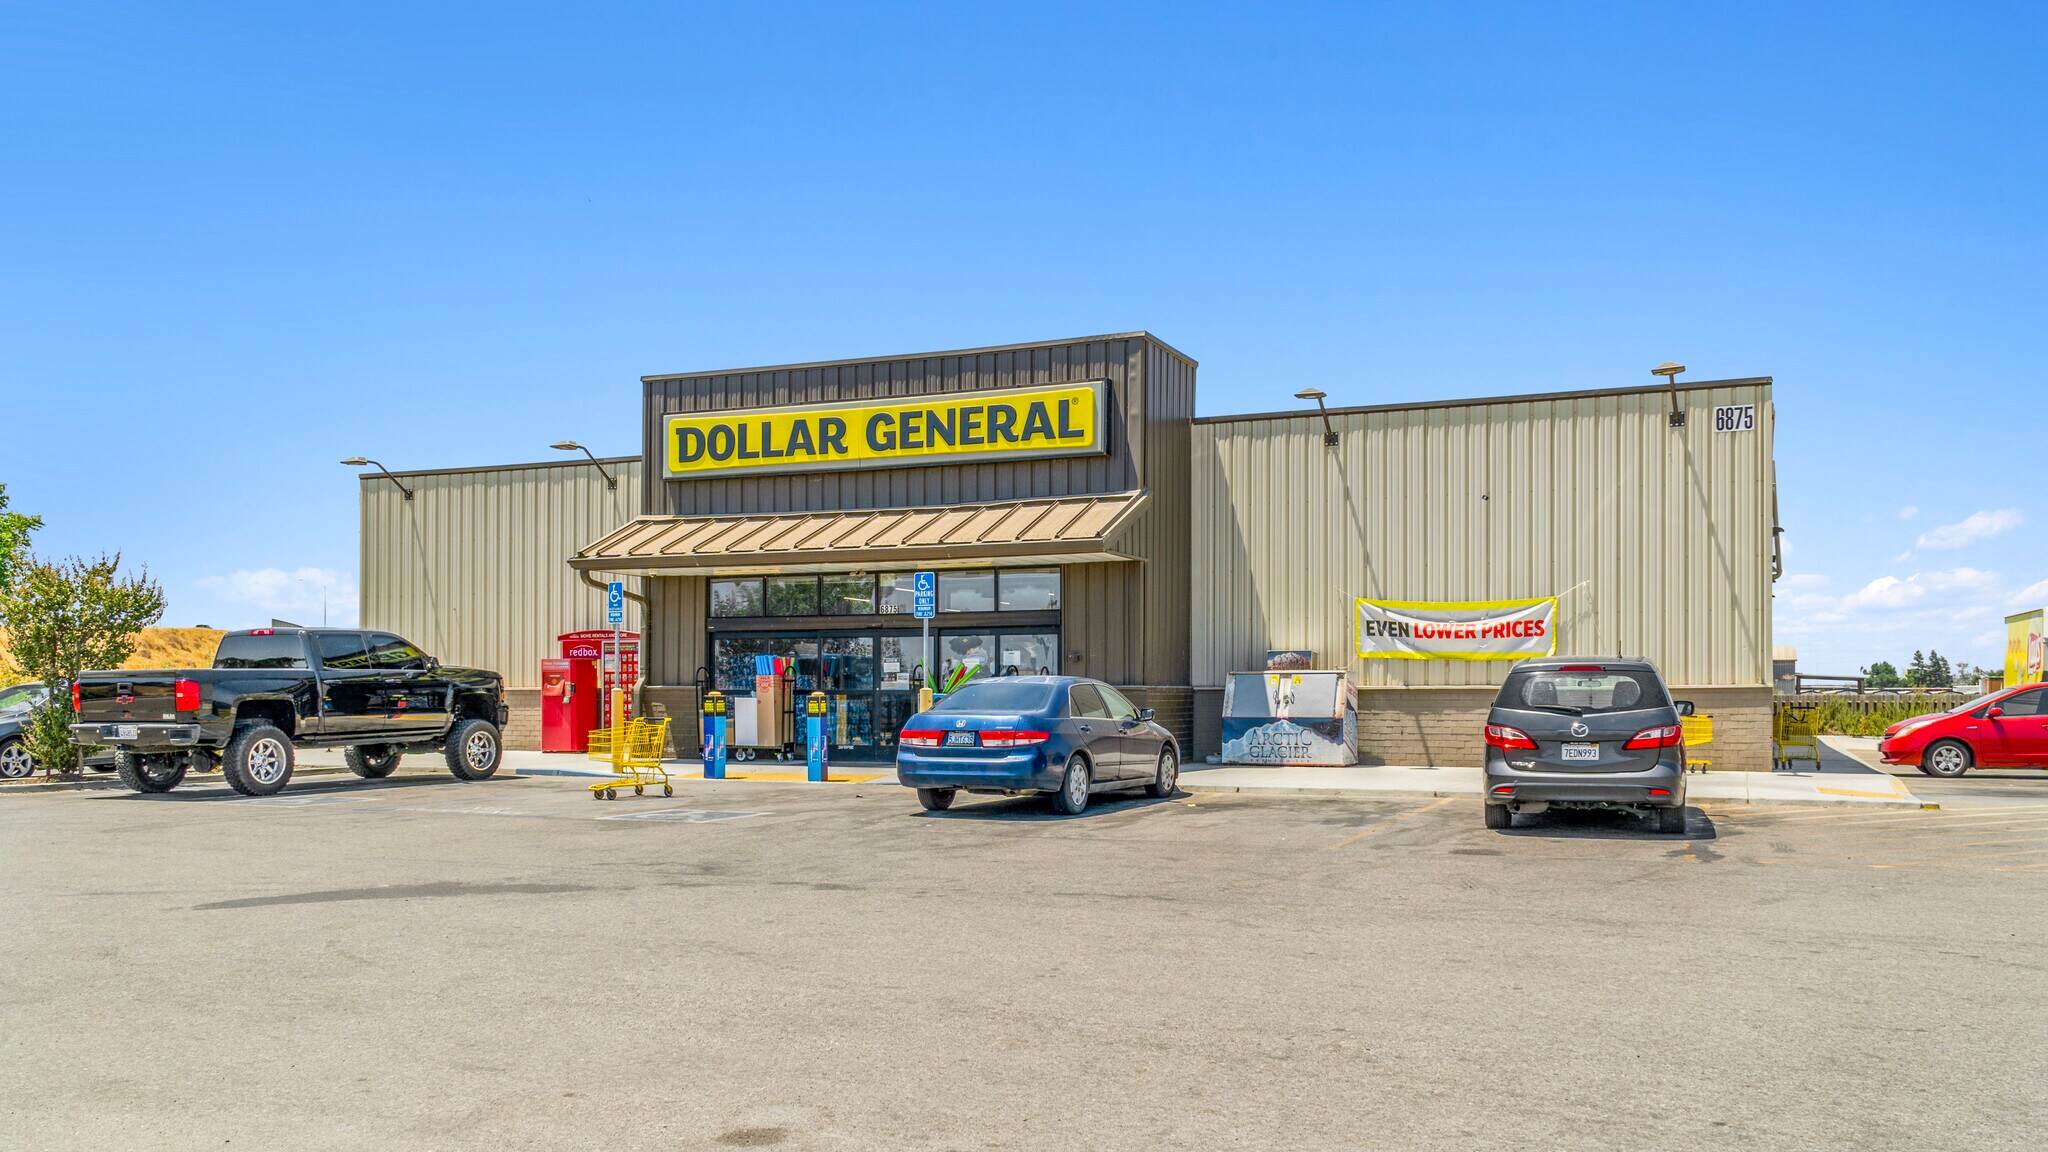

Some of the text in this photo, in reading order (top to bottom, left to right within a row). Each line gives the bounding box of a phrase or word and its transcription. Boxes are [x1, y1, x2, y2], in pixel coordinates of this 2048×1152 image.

[1716, 406, 1753, 431] 6875
[675, 399, 1085, 463] DOLLAR GENERAL
[880, 605, 898, 614] 6875
[1366, 619, 1545, 639] EVEN LOWER PRICES
[569, 648, 598, 657] redbox
[1249, 728, 1312, 746] ARCTIC
[1249, 746, 1312, 759] GLACIER
[1564, 748, 1597, 758] 7EDN993
